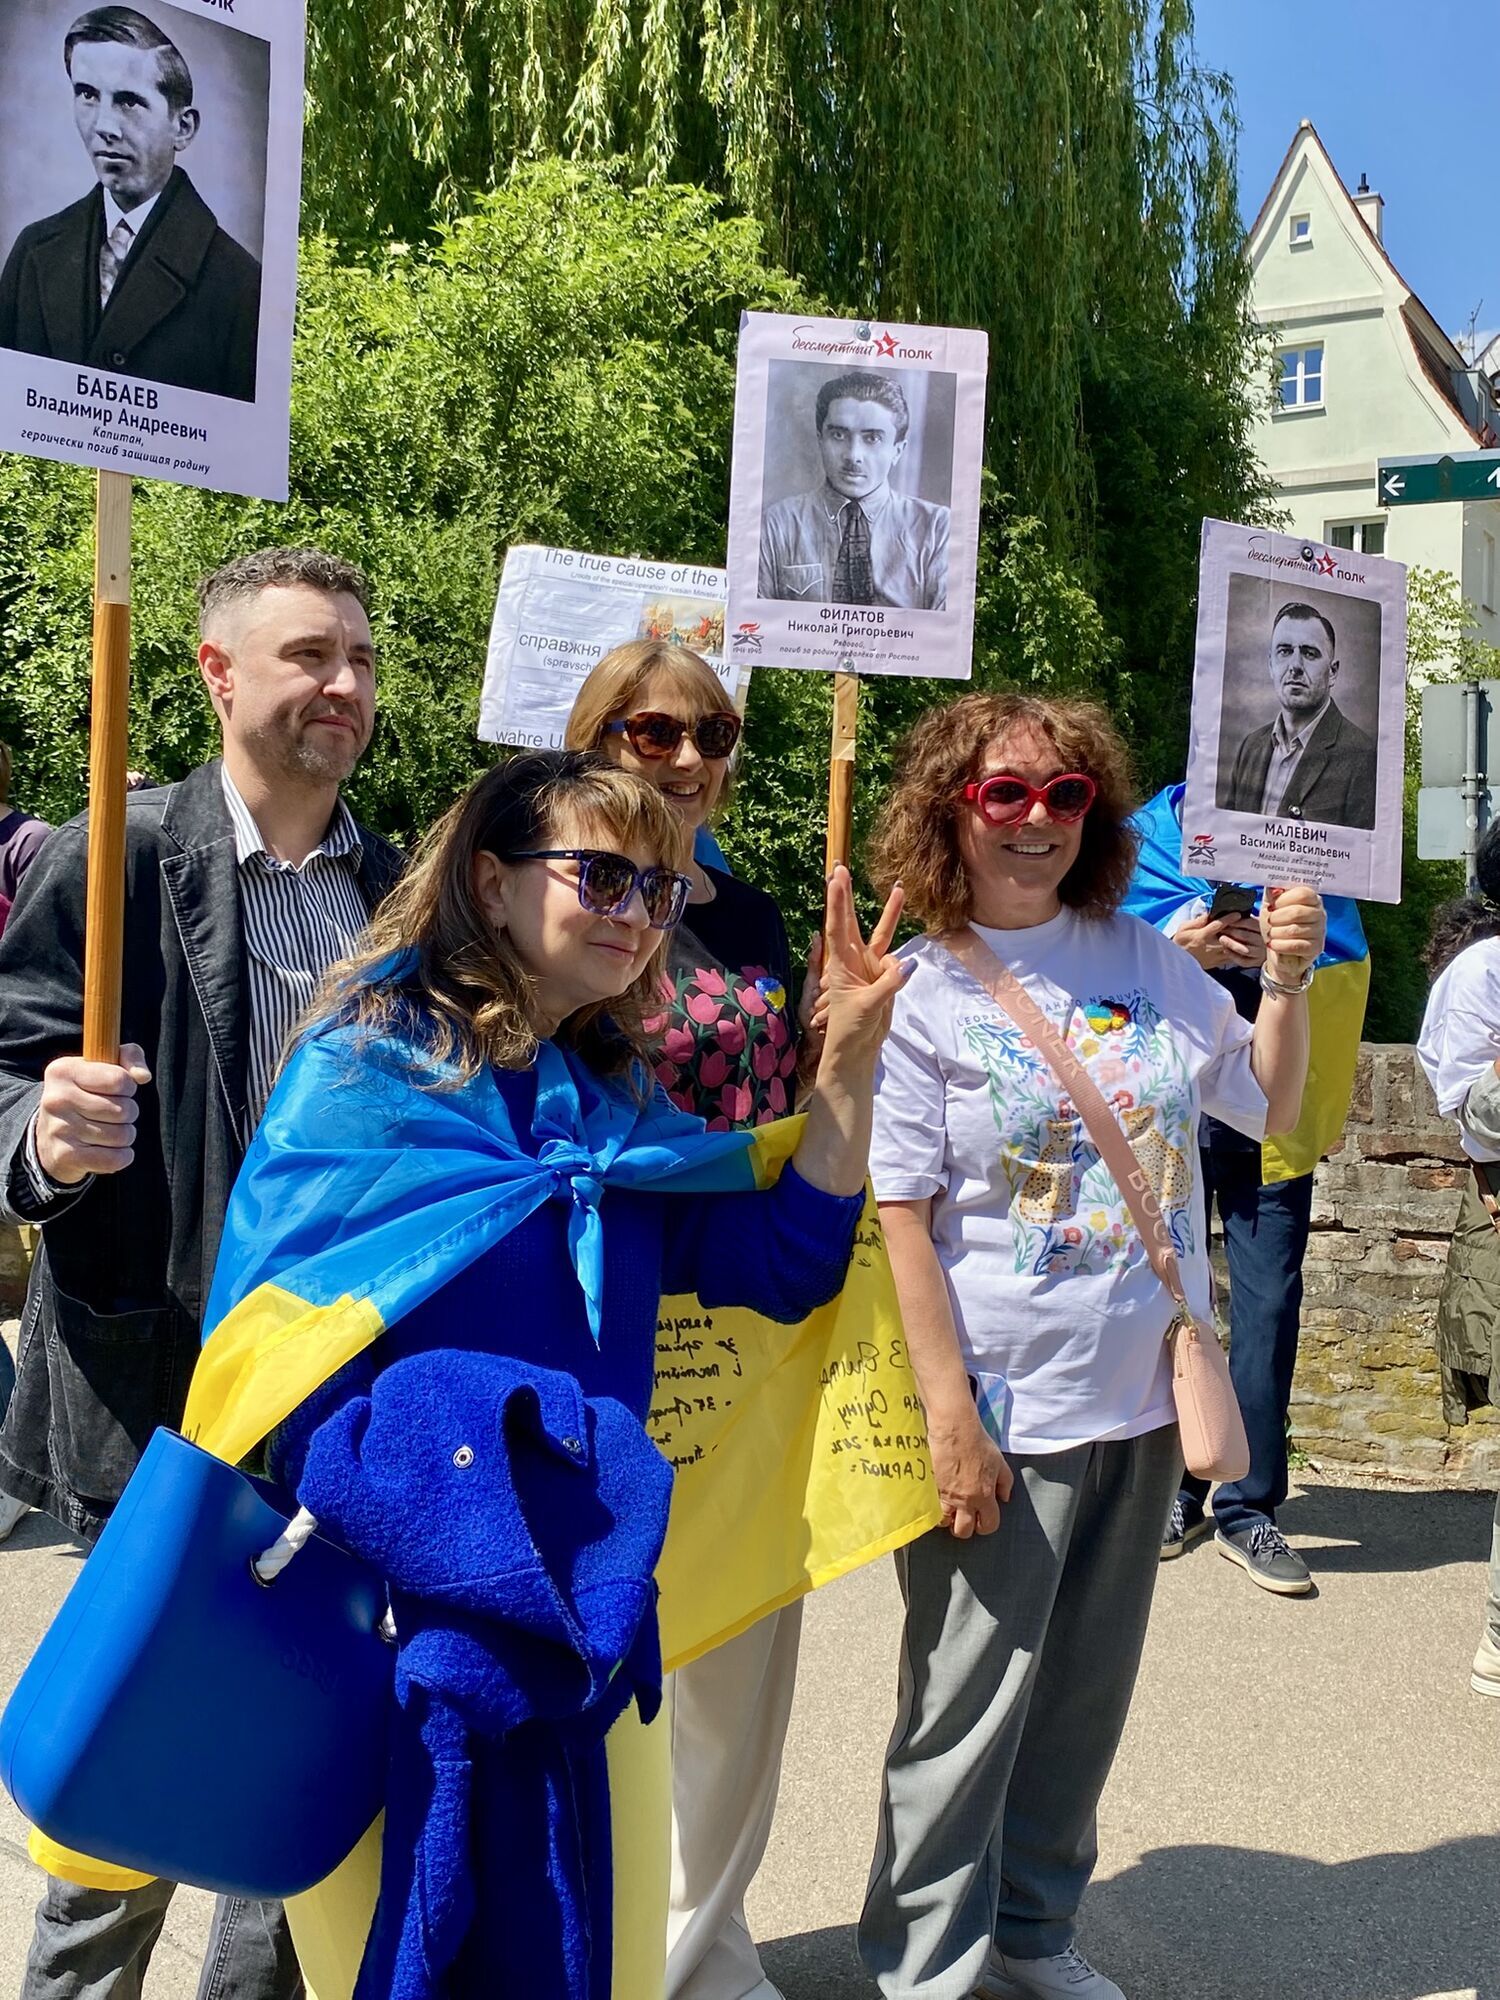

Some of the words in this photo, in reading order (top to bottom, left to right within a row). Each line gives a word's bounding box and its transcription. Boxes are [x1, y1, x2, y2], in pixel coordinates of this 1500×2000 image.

[77, 374, 159, 410] БАБАЕВ
[26, 389, 112, 425] Владимир
[118, 409, 207, 442] Андреевич
[93, 426, 145, 447] Капитан,
[21, 429, 84, 449] героически
[87, 442, 118, 456] погиб
[122, 448, 170, 465] защищая
[173, 459, 210, 474] родину
[544, 548, 573, 567] The
[579, 554, 611, 572] true
[616, 562, 666, 583] cause
[671, 567, 689, 584] of
[691, 568, 718, 587] the
[820, 608, 885, 623] ФИЛАТОВ
[788, 620, 838, 634] Николай
[842, 624, 914, 639] Григорьевич
[518, 633, 602, 657] справжня
[496, 729, 543, 747] wahre
[1264, 822, 1328, 843] МАЛЕВИЧ
[1240, 834, 1286, 851] Василий
[1289, 842, 1350, 860] Васильевич
[956, 1011, 1007, 1027] LEOPAR
